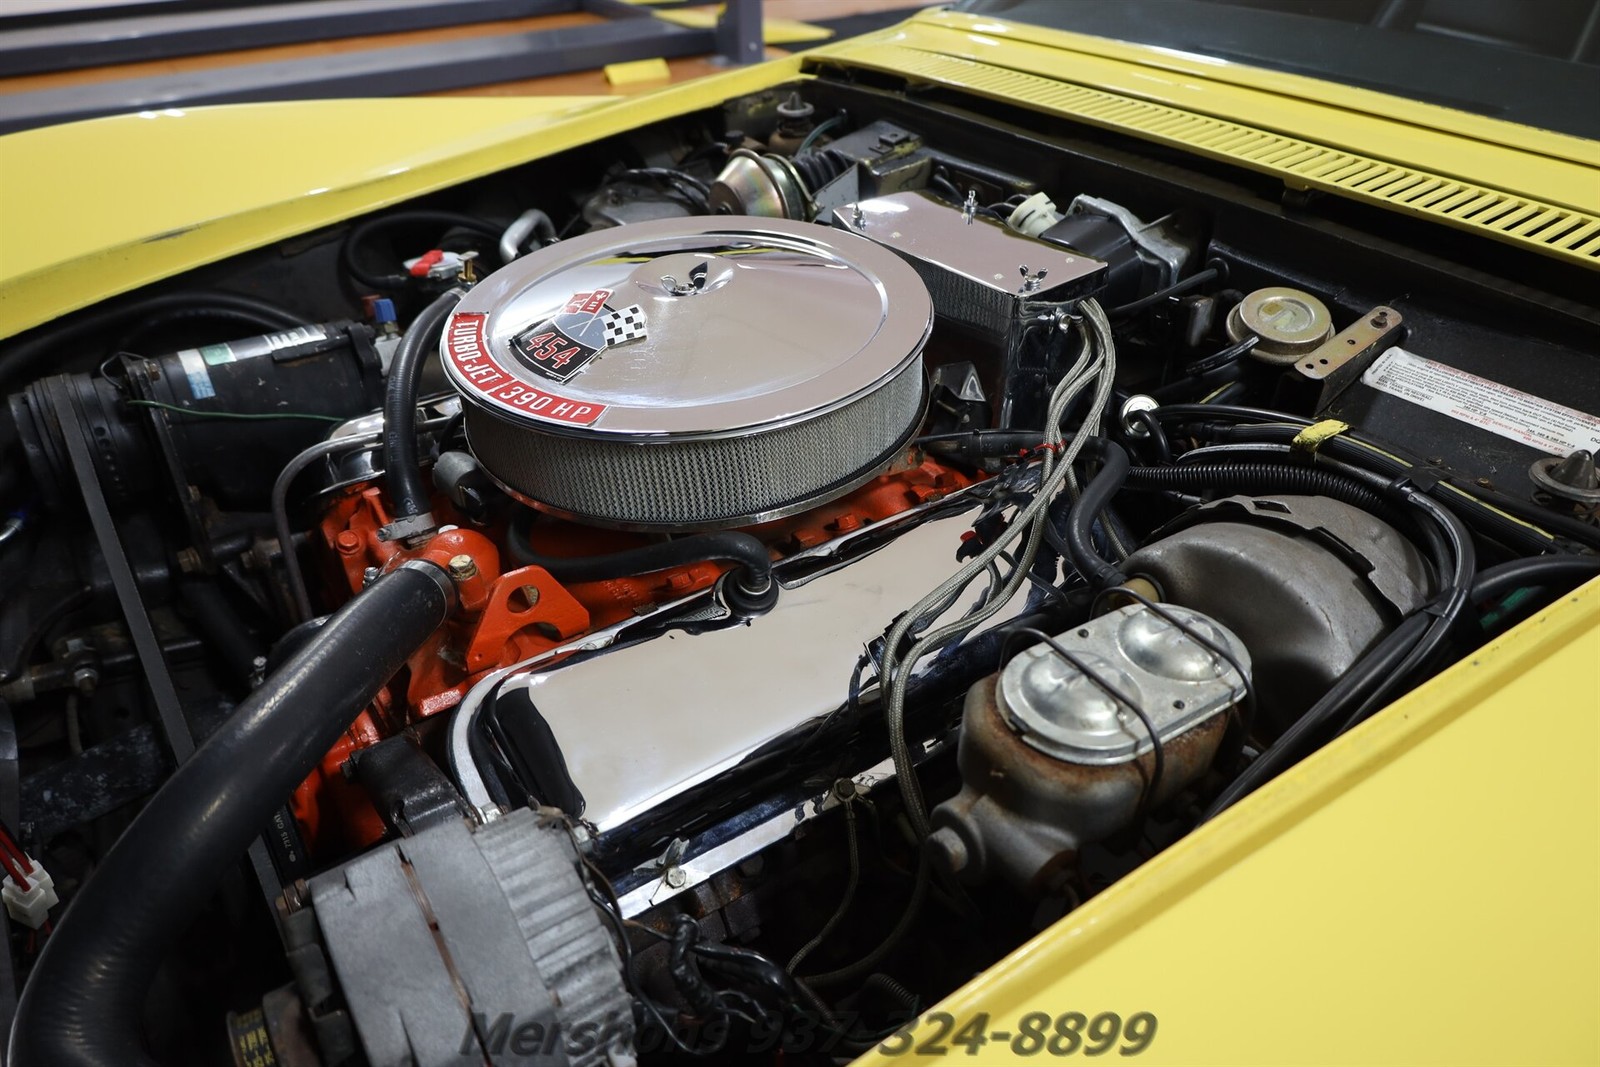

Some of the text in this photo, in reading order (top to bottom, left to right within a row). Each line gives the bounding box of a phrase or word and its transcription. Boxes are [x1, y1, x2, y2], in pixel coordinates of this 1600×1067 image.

[452, 319, 593, 420] TURBO-JET 390 HP
[525, 331, 581, 369] 454
